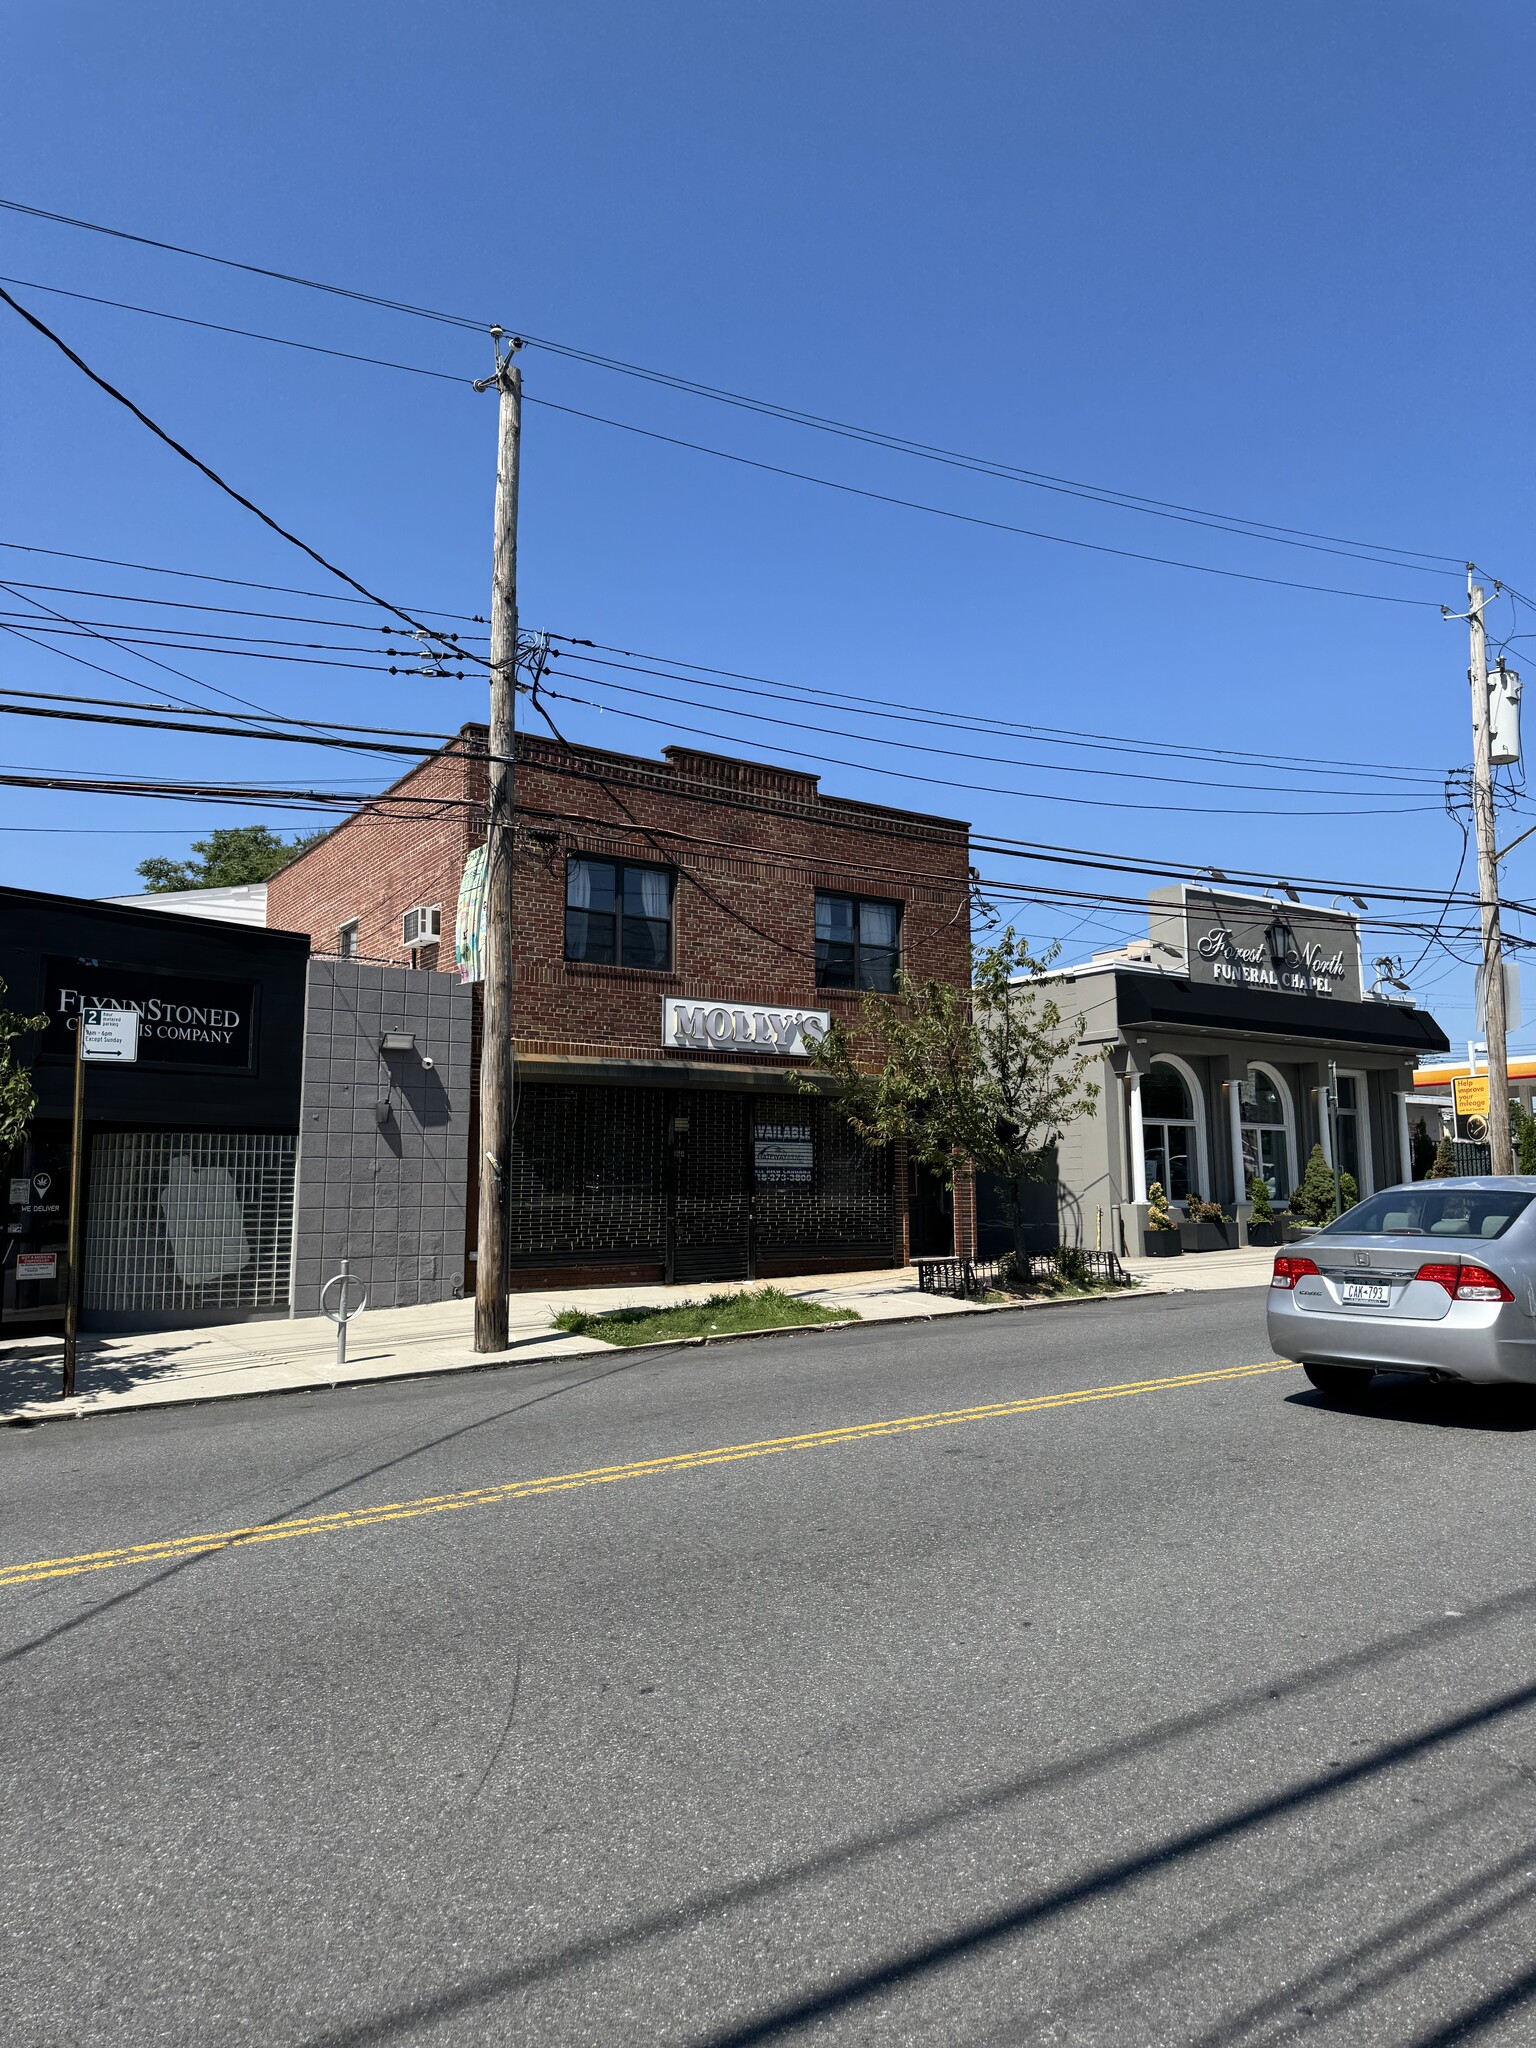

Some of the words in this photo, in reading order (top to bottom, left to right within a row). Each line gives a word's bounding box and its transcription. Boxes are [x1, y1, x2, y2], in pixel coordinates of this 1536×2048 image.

[1197, 928, 1266, 964] Forest
[1285, 941, 1345, 976] North
[1213, 963, 1278, 985] FUNERAL
[1281, 972, 1333, 993] CHAPEL
[88, 1010, 97, 1024] 2
[674, 1005, 825, 1047] MOLLY'S
[104, 1036, 122, 1044] Sunday
[156, 1026, 233, 1044] COMPANY
[754, 1124, 811, 1140] VAILABLE
[754, 1173, 812, 1182] 18-273-3800
